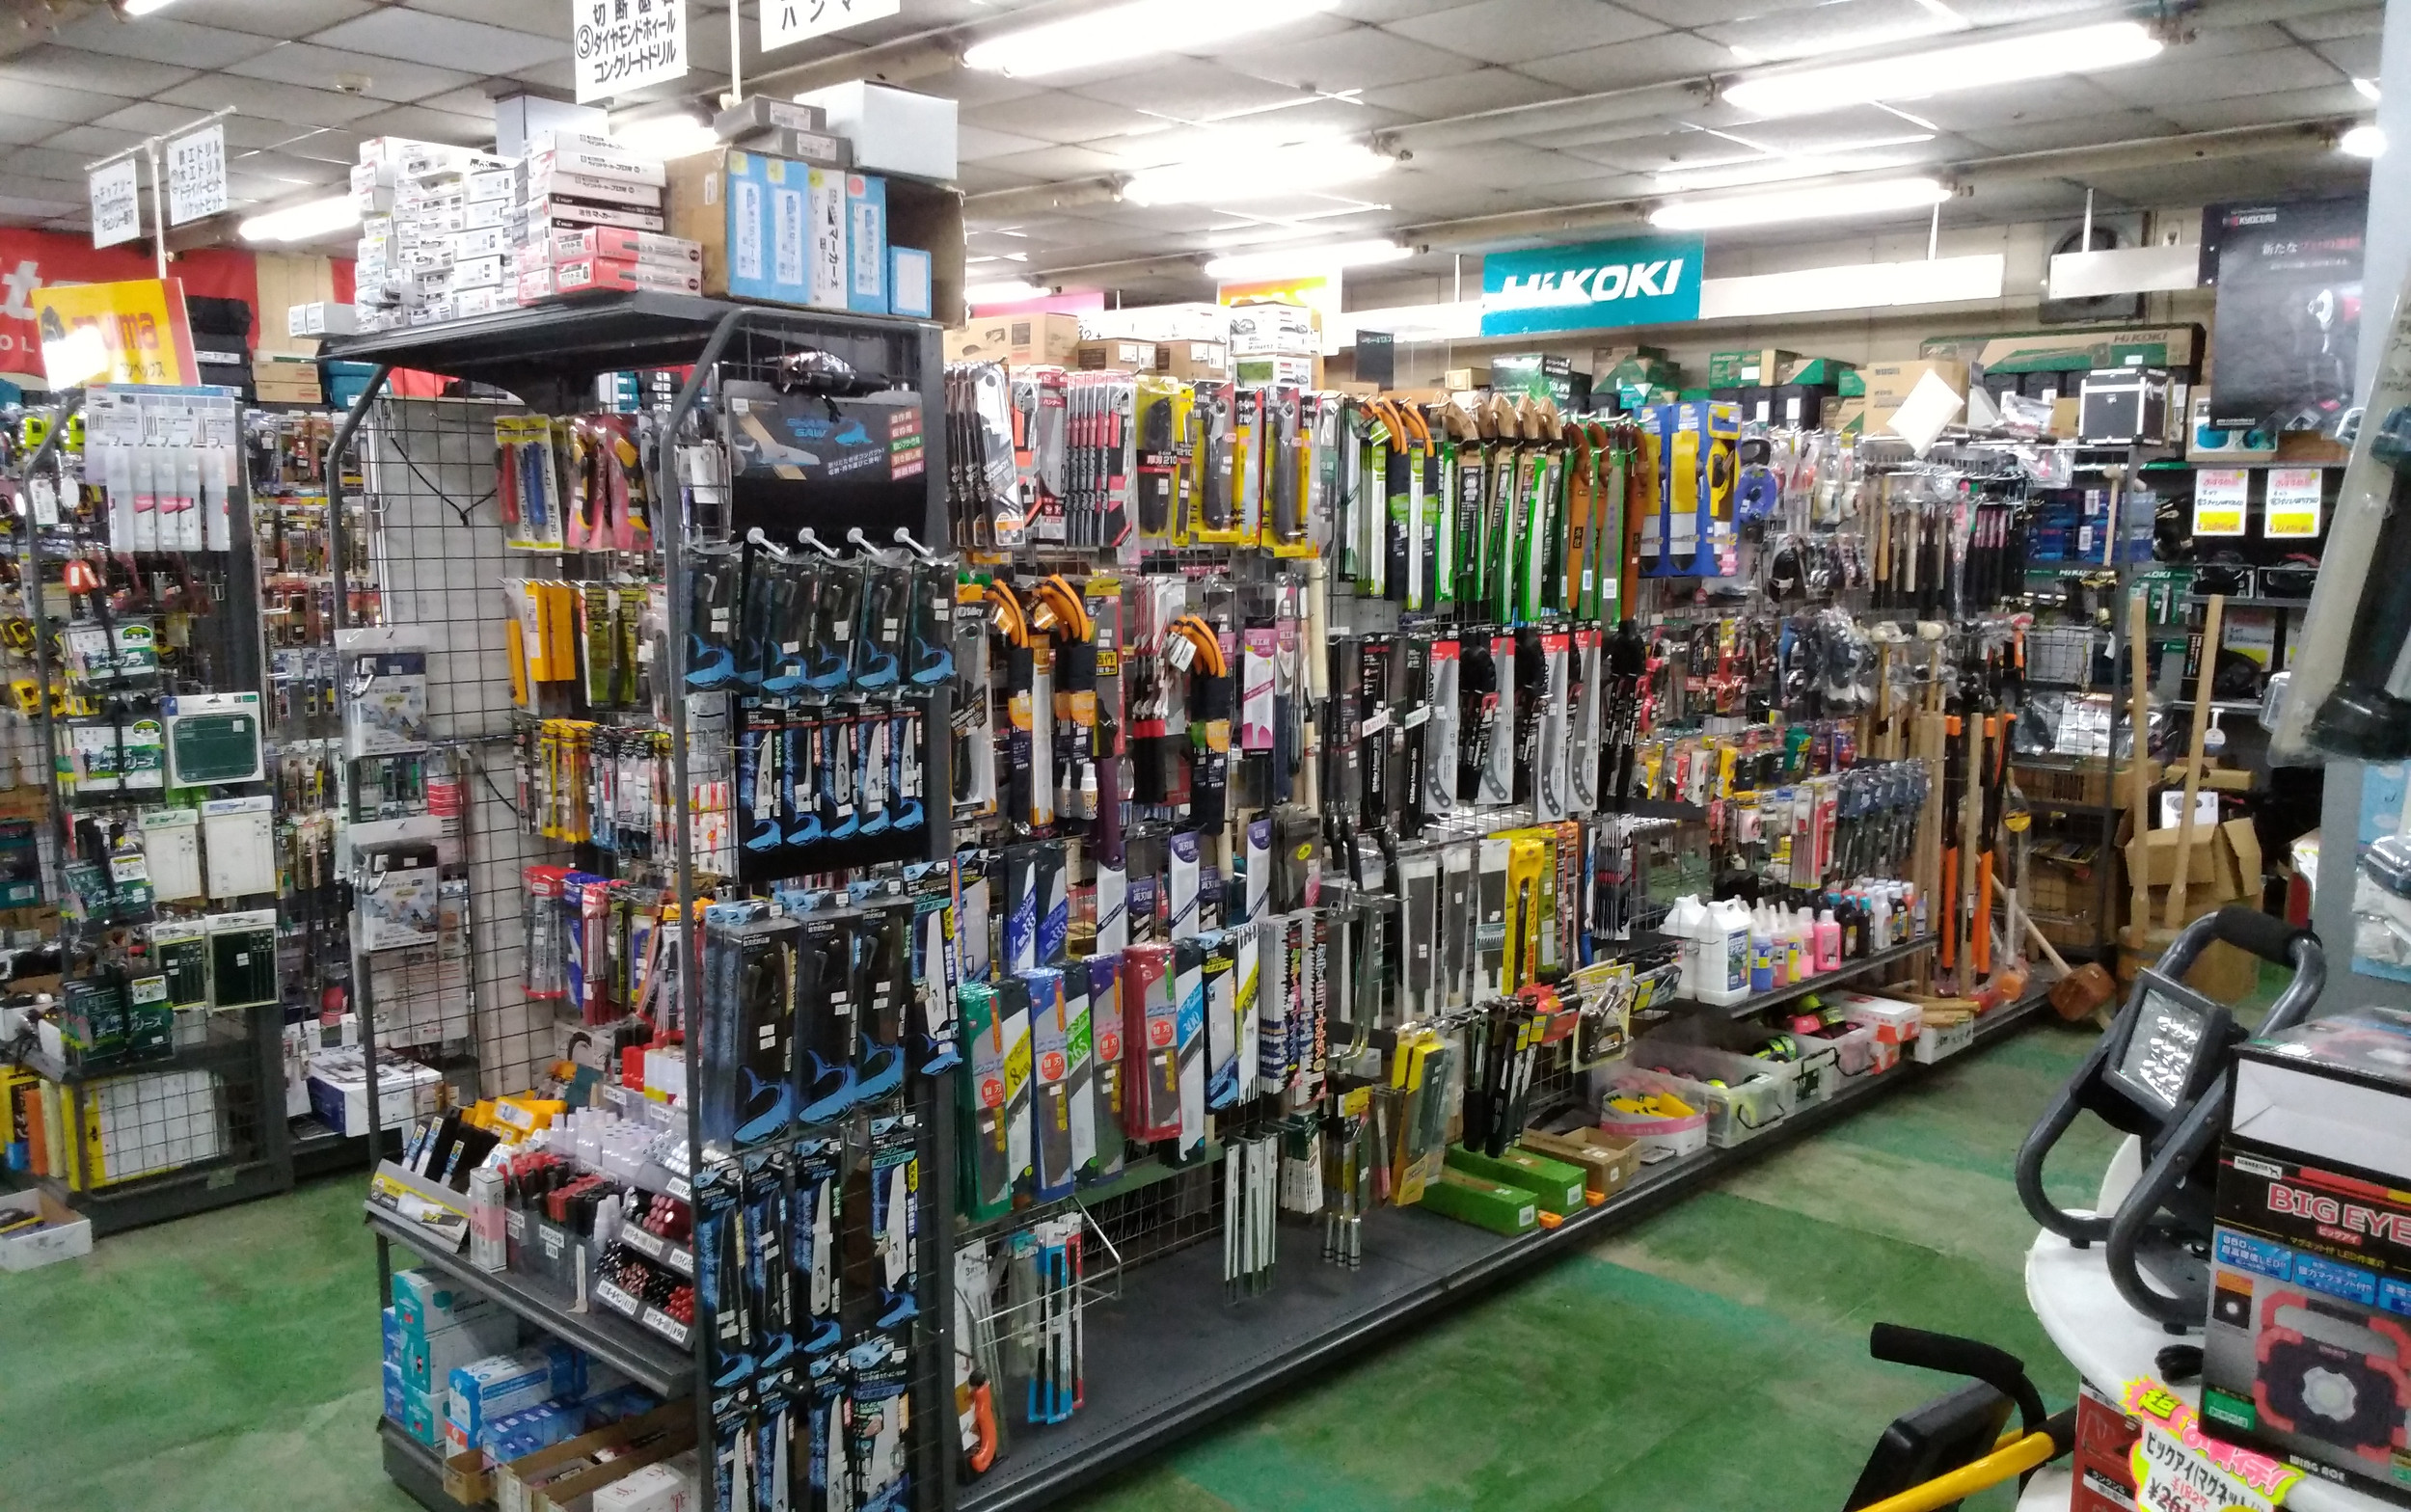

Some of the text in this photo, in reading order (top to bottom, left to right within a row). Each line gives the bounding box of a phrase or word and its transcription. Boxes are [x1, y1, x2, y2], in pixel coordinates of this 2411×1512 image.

[593, 10, 676, 56] ダイヤモンドホイール
[594, 40, 676, 84] コンクリートドリル
[2239, 214, 2277, 225] KYOCERA
[795, 428, 827, 437] SAW
[965, 607, 984, 617] Silky
[1021, 911, 1037, 937] 333
[1315, 943, 1328, 1059] タテ・ヨコ・ナナメ
[2267, 1182, 2411, 1248] BIG EYE
